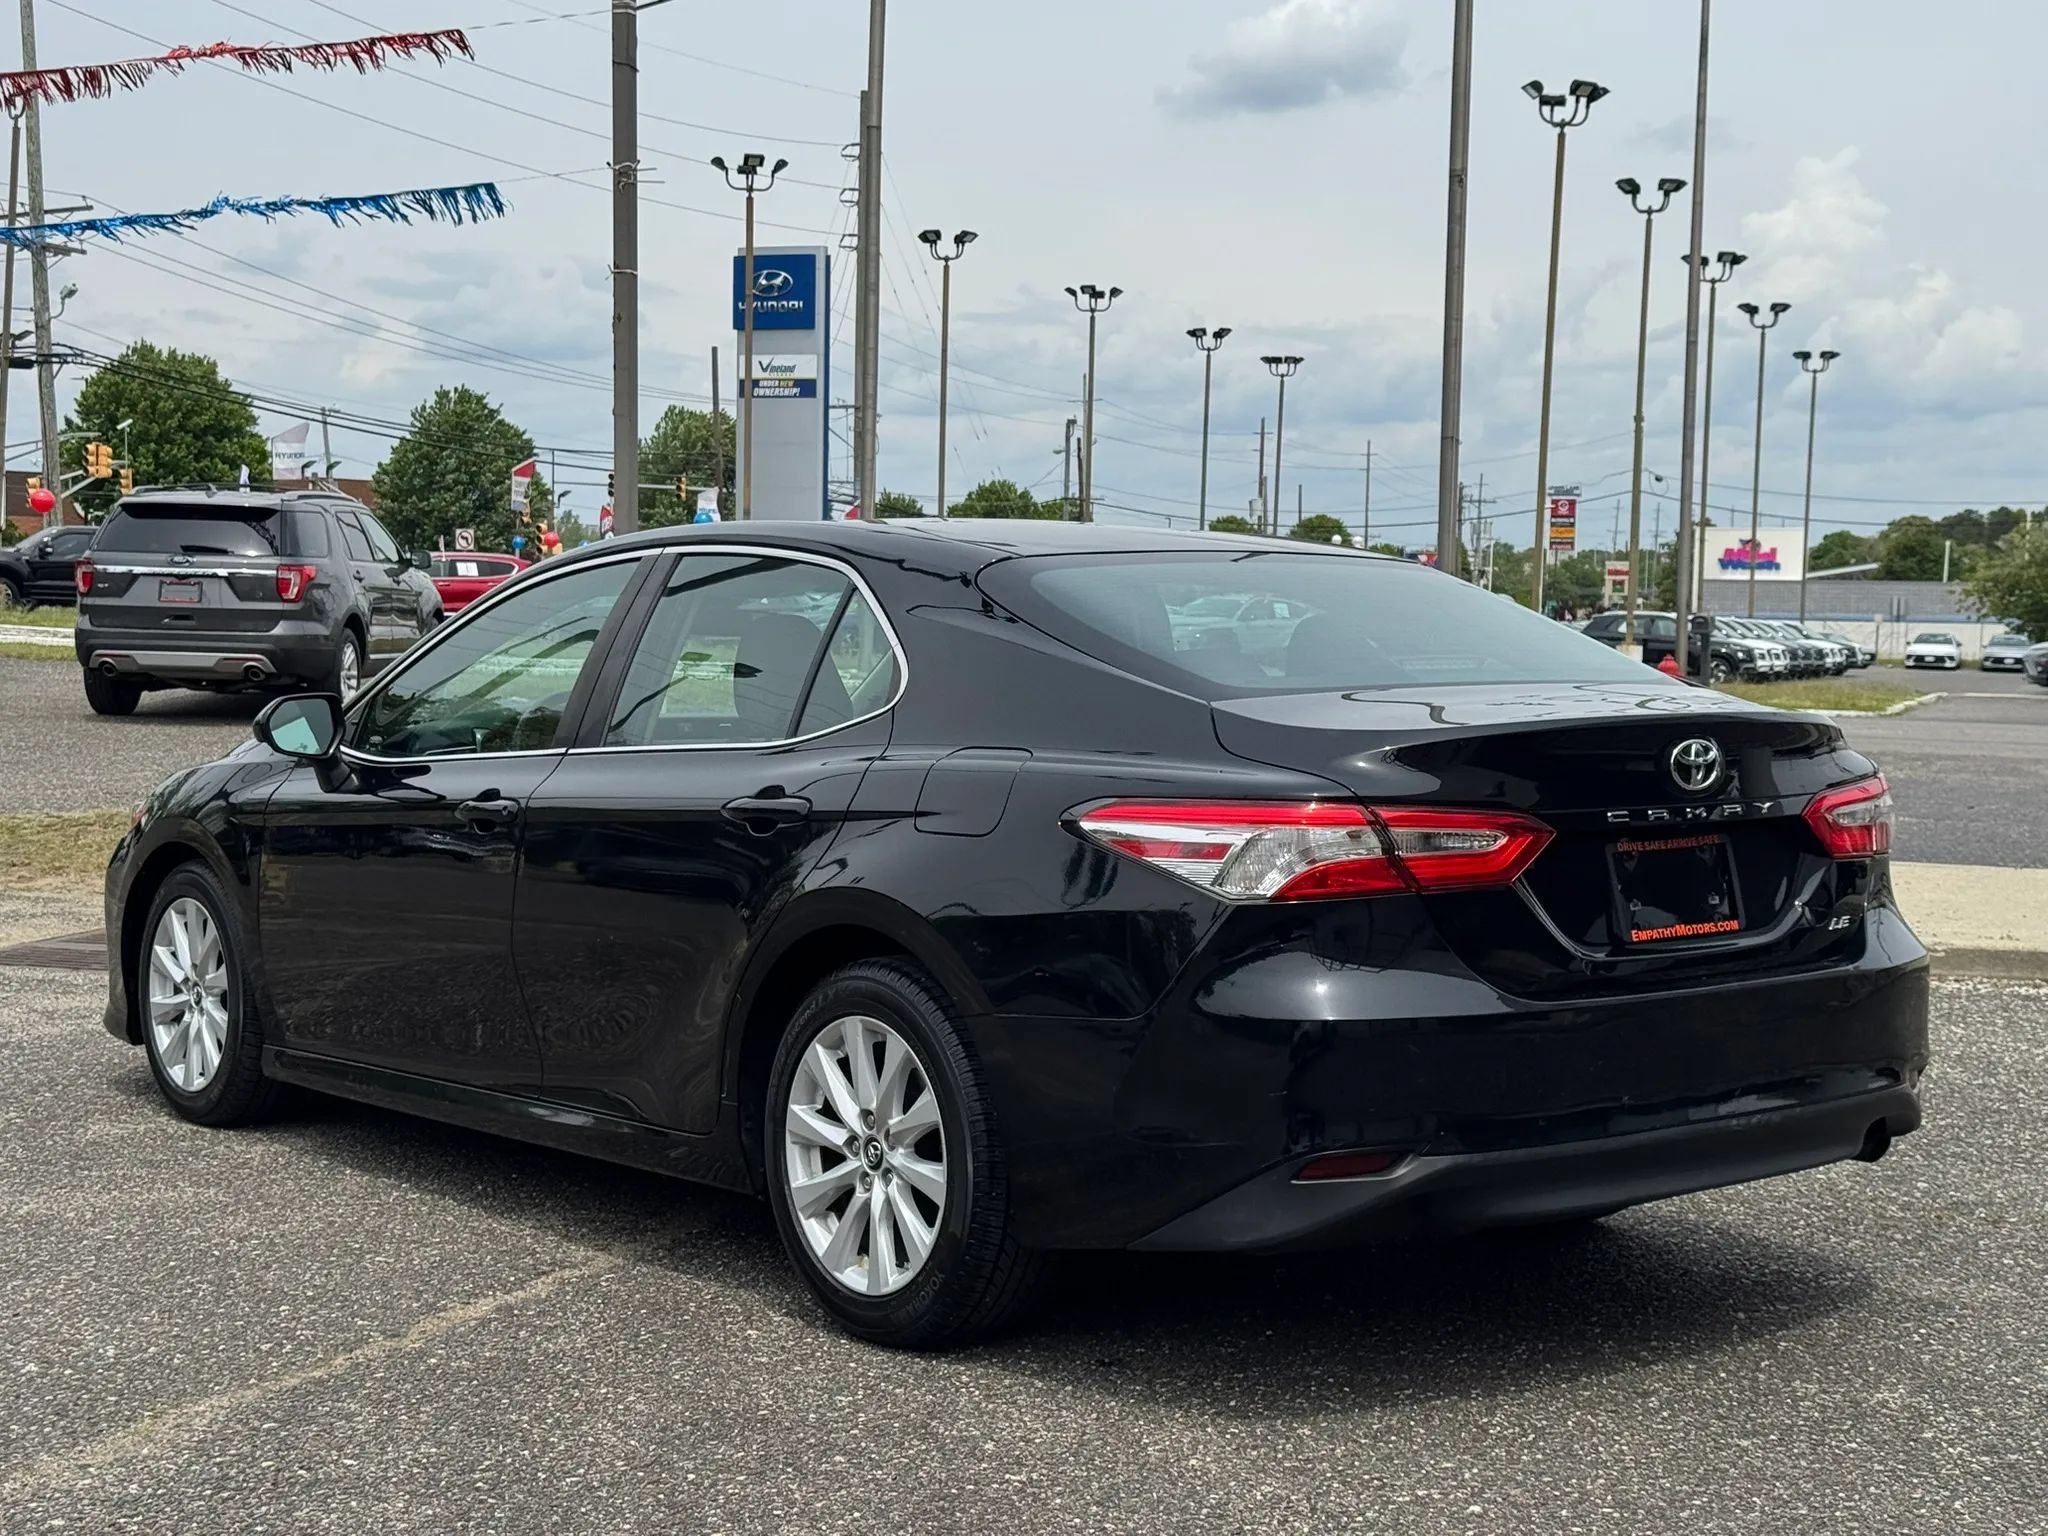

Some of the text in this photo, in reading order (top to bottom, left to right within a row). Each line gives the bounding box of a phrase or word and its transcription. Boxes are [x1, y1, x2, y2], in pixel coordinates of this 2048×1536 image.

[758, 356, 797, 373] Vineland
[759, 379, 795, 388] UNDER NEW
[753, 387, 801, 397] OWNERSHIP!
[1606, 801, 1775, 823] CAMRY
[1616, 834, 1721, 853] DRIVE SAFE ARRIVE SAFE
[1828, 915, 1852, 931] LE
